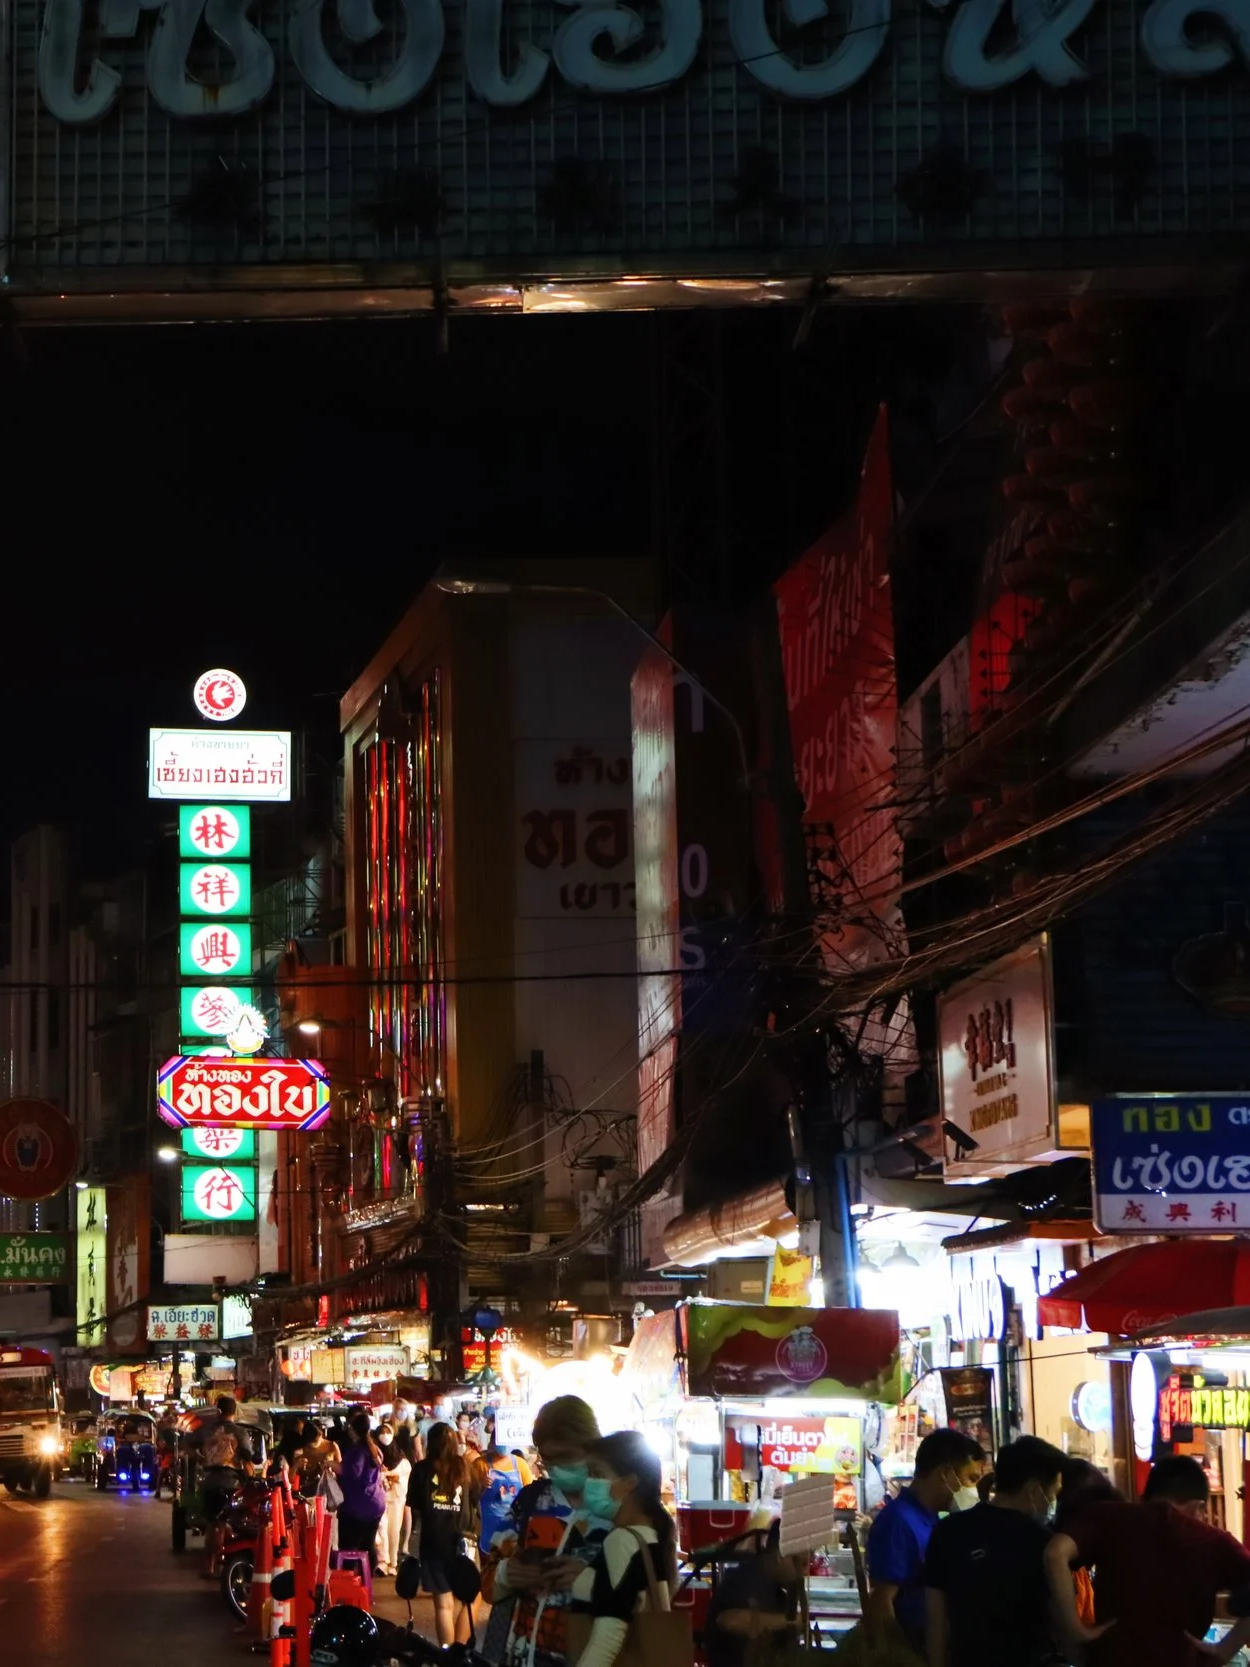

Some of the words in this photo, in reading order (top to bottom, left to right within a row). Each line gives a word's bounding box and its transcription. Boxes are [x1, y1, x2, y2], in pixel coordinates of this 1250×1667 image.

[185, 1063, 252, 1083] ห้างทอง
[176, 1069, 314, 1118] ทองใบ
[433, 1502, 461, 1512] PEANUTS
